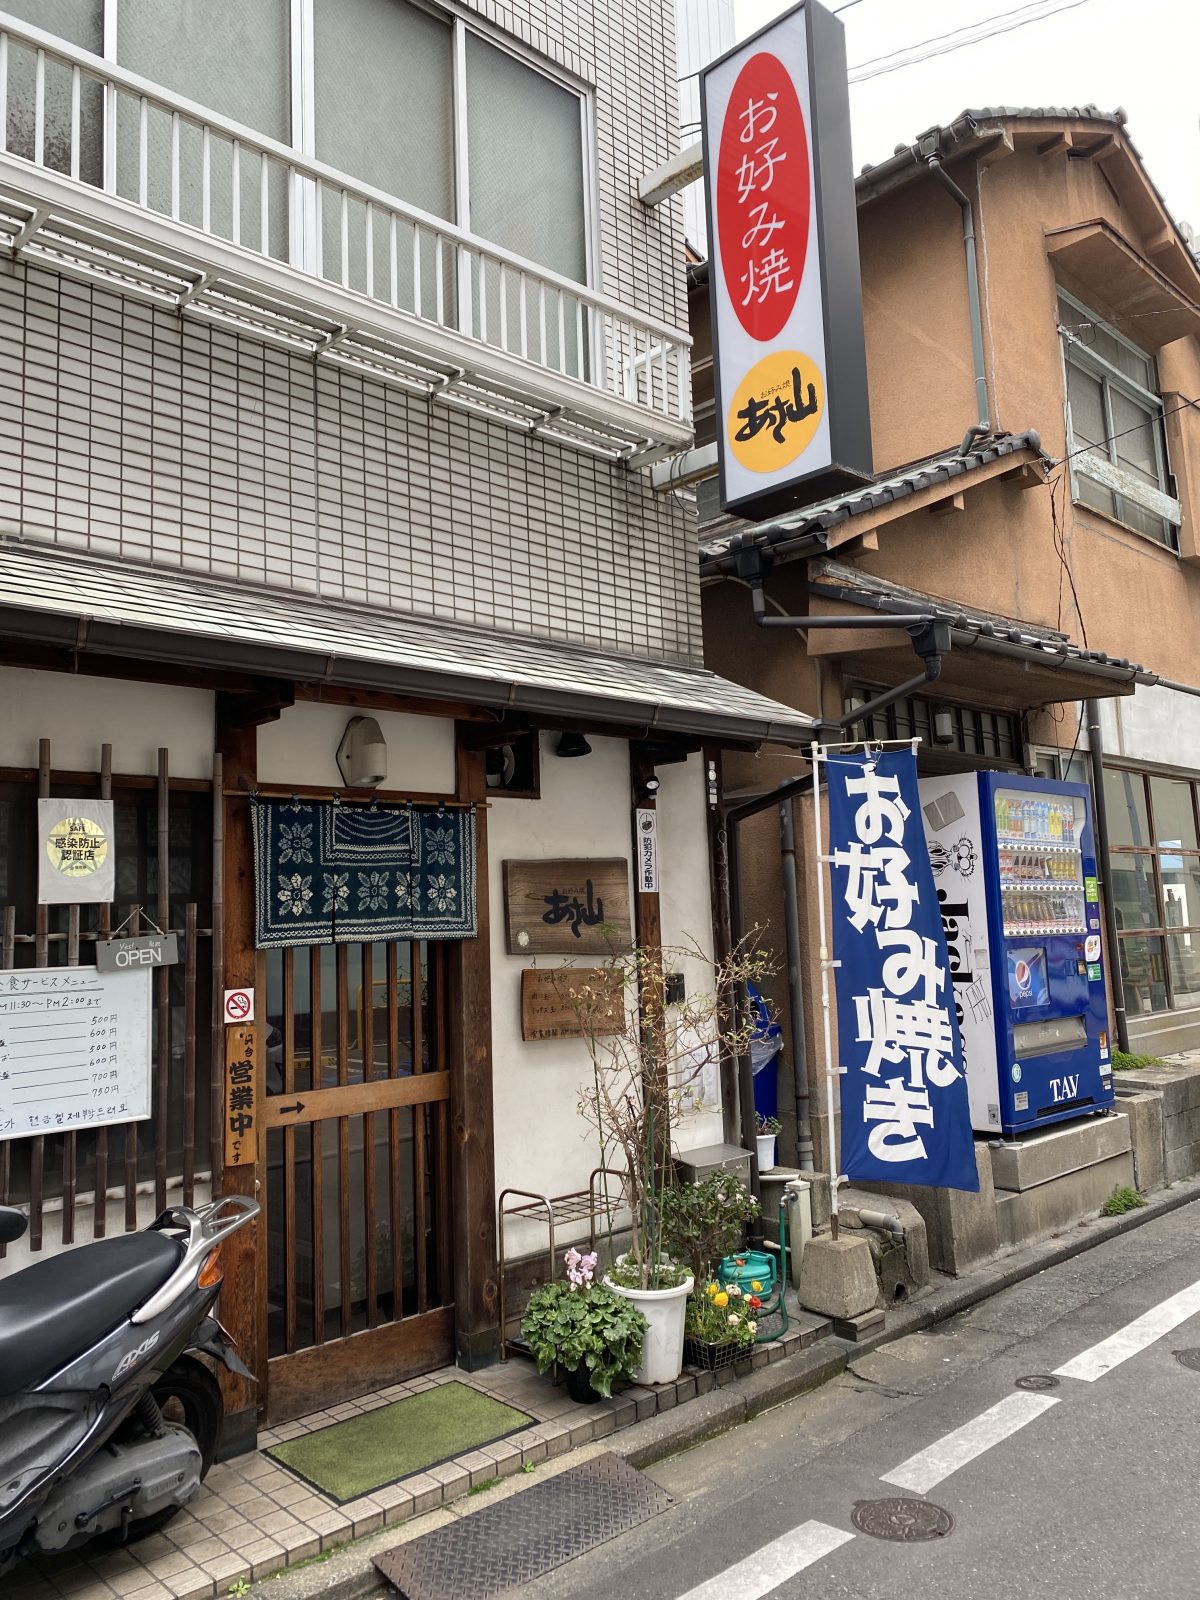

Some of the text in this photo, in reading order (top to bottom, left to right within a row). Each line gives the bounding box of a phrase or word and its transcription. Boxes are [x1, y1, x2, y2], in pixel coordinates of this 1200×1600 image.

[735, 92, 794, 307] お好み焼
[760, 379, 792, 399] お好み焼
[735, 367, 818, 444] あさ山
[55, 837, 101, 849] 感染防止
[61, 849, 95, 861] 認証店
[643, 836, 654, 890] 防犯カメラ作動中
[542, 879, 605, 939] あさ山
[115, 947, 162, 967] OPEN
[833, 764, 962, 1163] お好み焼き
[1019, 989, 1033, 999] pepsi
[90, 1014, 118, 1026] 500円
[90, 1027, 117, 1038] 600円
[89, 1041, 117, 1054] 500円
[89, 1054, 118, 1067] 600円
[92, 1070, 118, 1082] 700円
[92, 1084, 119, 1098] 750円
[112, 1330, 161, 1381] AXIS
